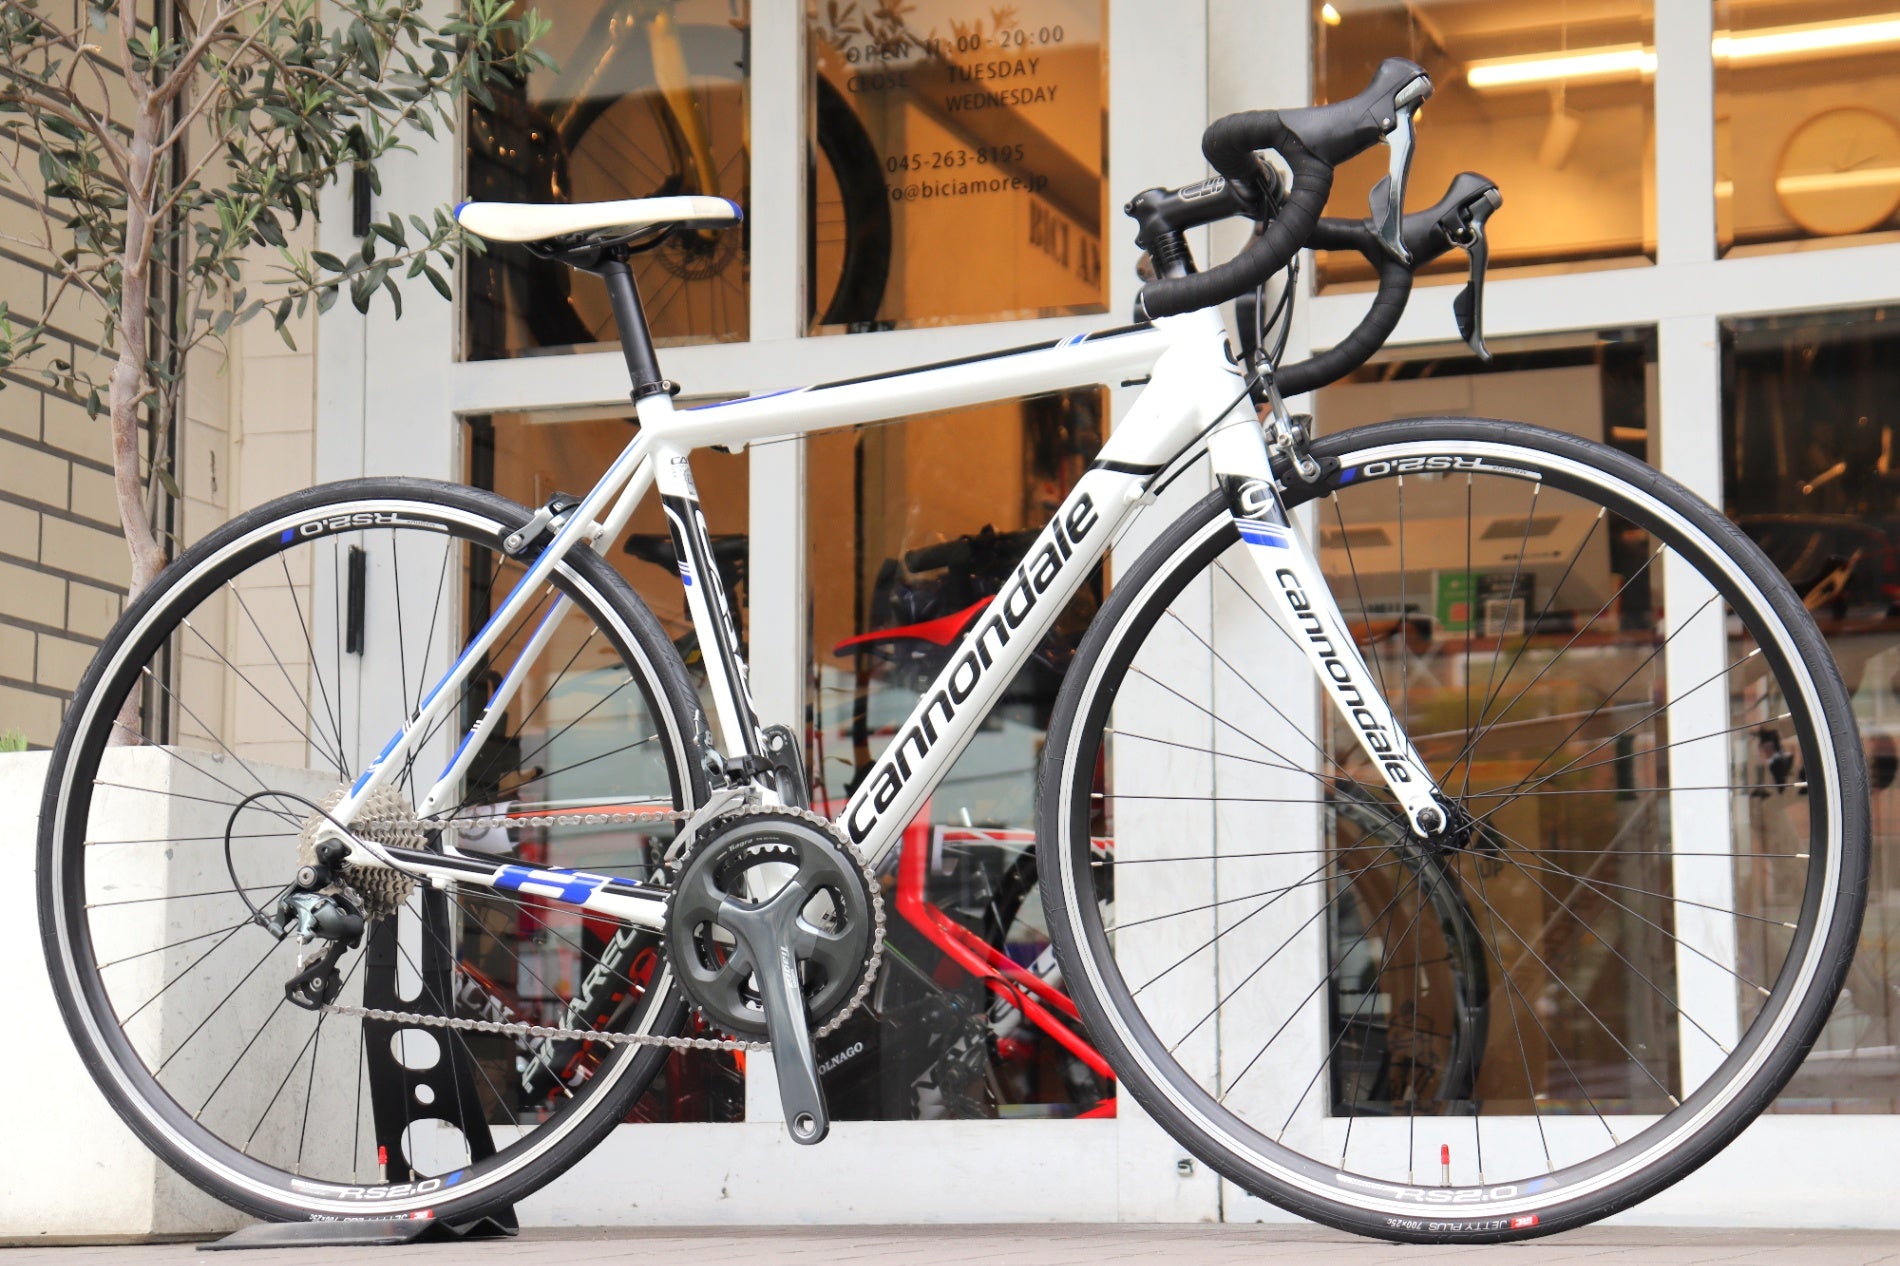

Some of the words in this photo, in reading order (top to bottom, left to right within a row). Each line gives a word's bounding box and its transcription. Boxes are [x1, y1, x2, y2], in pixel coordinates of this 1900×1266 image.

[846, 42, 909, 64] OPEN
[924, 33, 981, 57] 11:00
[1000, 25, 1064, 48] 20:00
[846, 72, 908, 94] CLOSE
[946, 57, 1040, 83] TUESDAY
[945, 85, 1058, 112] WEDNESDAY
[886, 144, 1025, 173] 045-263-8195
[848, 491, 1099, 844] cannondale
[1275, 567, 1412, 784] cannondale
[818, 1041, 863, 1075] OLNAGO
[338, 1178, 441, 1200] RS2.0
[1393, 1185, 1518, 1203] RS2.0
[1428, 1222, 1462, 1232] PLUS
[1465, 1219, 1508, 1231] JETTY
